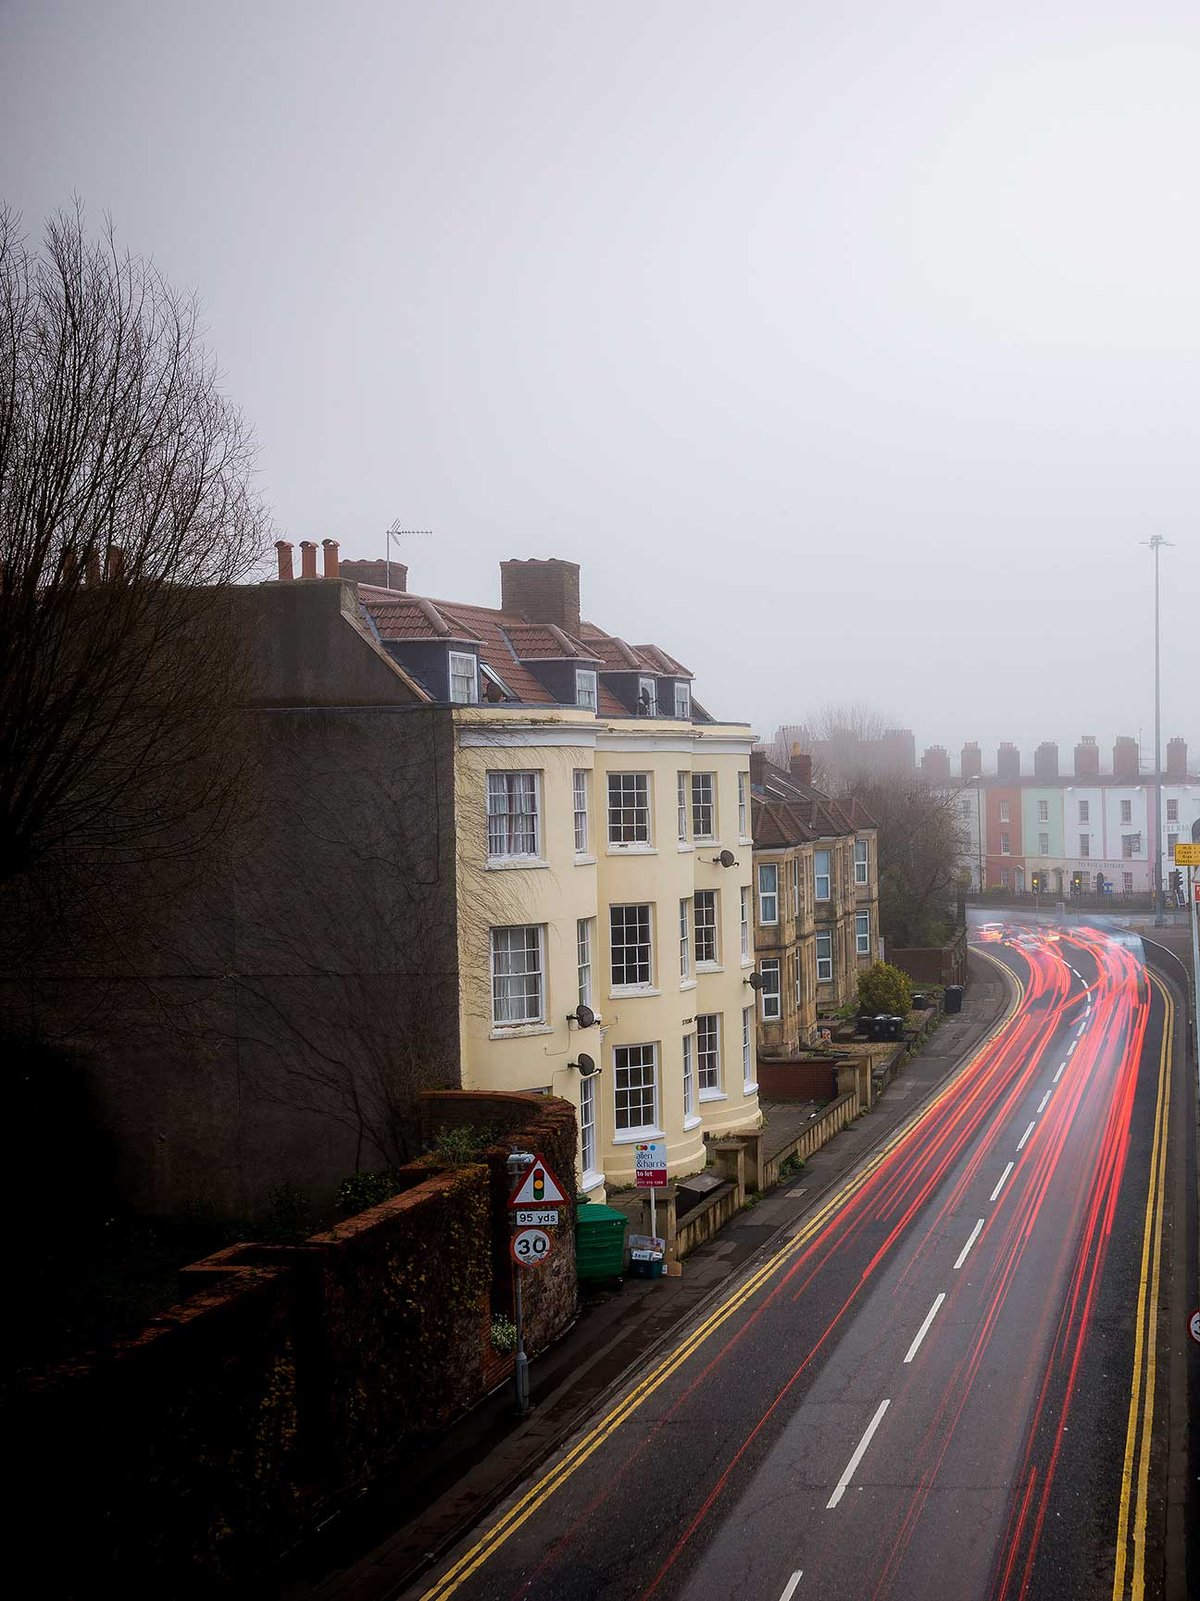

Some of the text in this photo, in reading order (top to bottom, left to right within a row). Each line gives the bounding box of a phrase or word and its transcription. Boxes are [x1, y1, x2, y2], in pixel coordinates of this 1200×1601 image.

[635, 1151, 653, 1160] allen
[636, 1160, 666, 1168] &harris
[519, 1213, 556, 1224] 95 yds
[517, 1238, 547, 1255] 30
